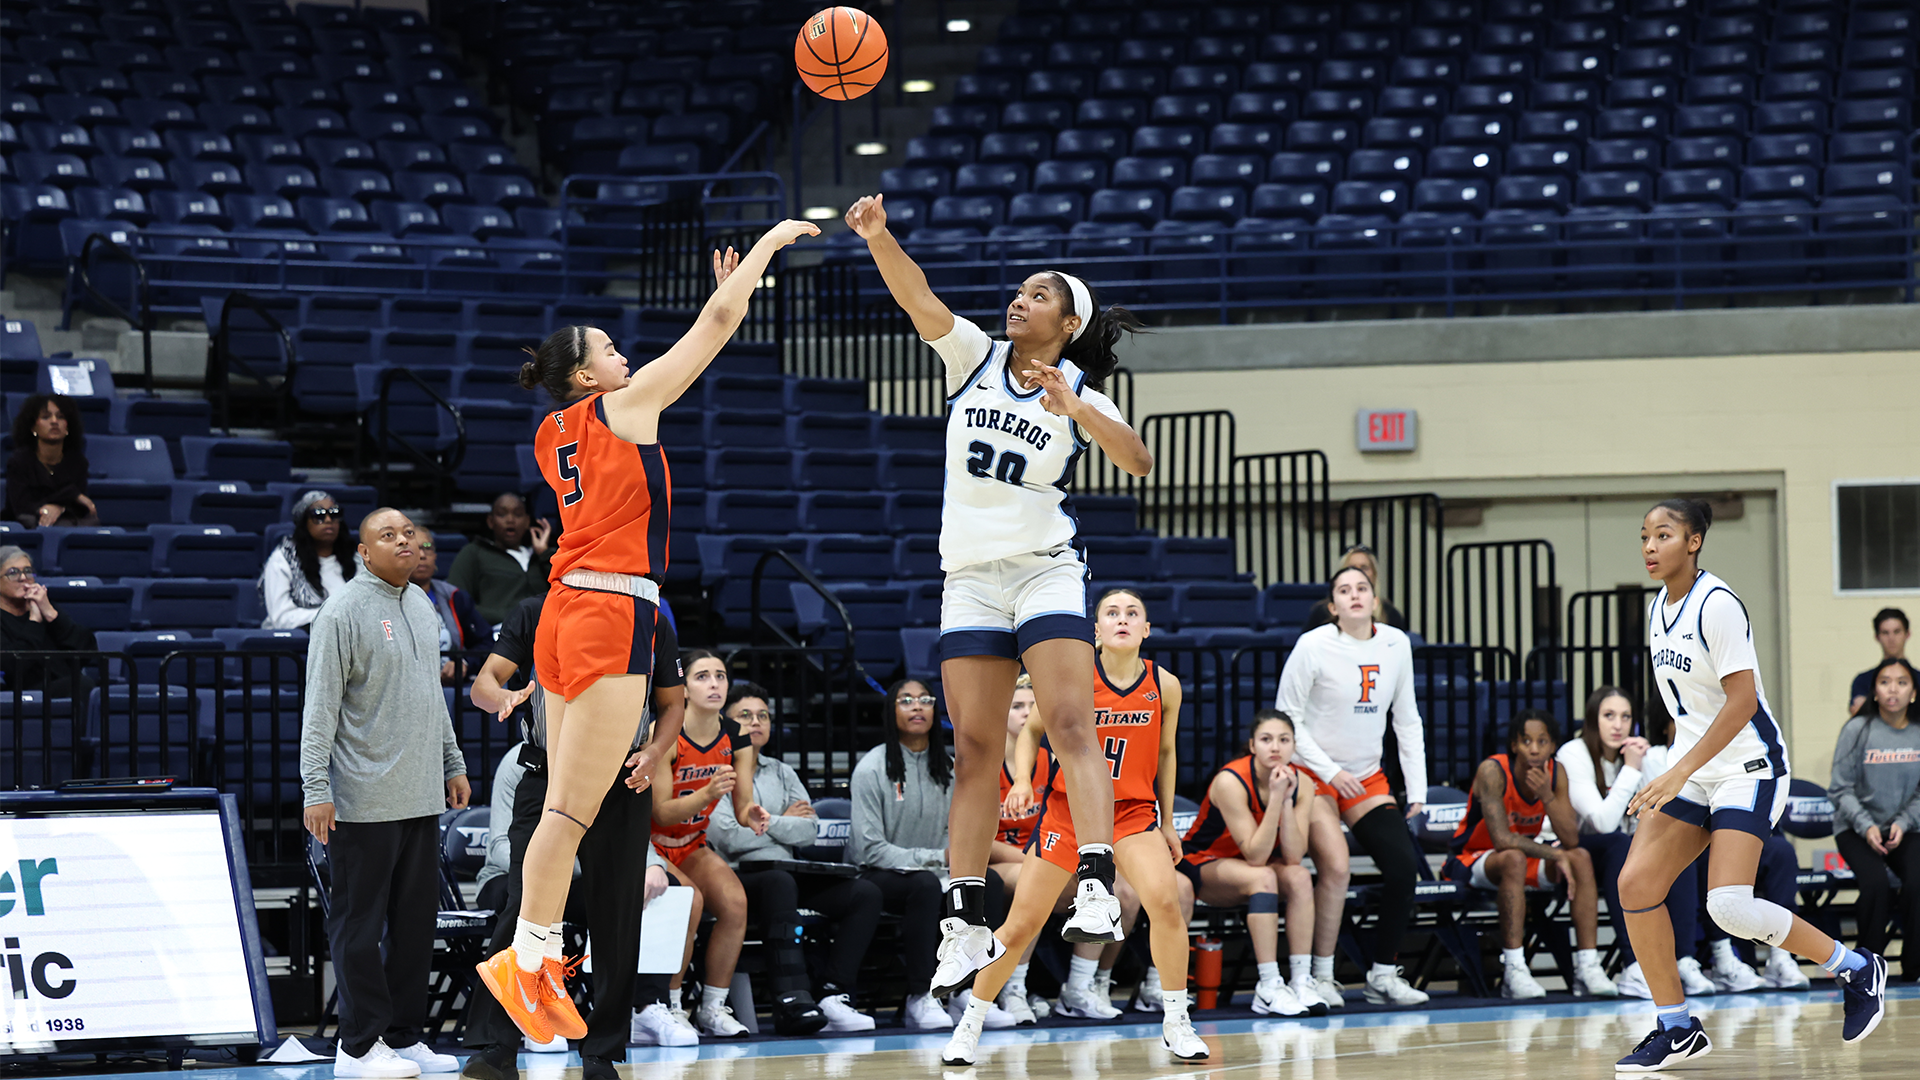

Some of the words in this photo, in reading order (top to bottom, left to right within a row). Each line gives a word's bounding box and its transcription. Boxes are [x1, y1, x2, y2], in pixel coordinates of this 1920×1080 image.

[553, 412, 565, 433] F
[965, 408, 1052, 451] TOREROS
[1369, 412, 1406, 443] EXIT
[556, 440, 584, 508] 5
[966, 439, 1029, 486] 20
[381, 620, 393, 640] F
[1653, 648, 1692, 673] TOREROS
[1357, 664, 1380, 703] F
[1667, 678, 1688, 717] 1
[679, 765, 722, 782] TITAN
[1103, 736, 1128, 780] 4
[1043, 831, 1061, 851] F
[0, 937, 77, 999] ic
[45, 1018, 85, 1031] 1938
